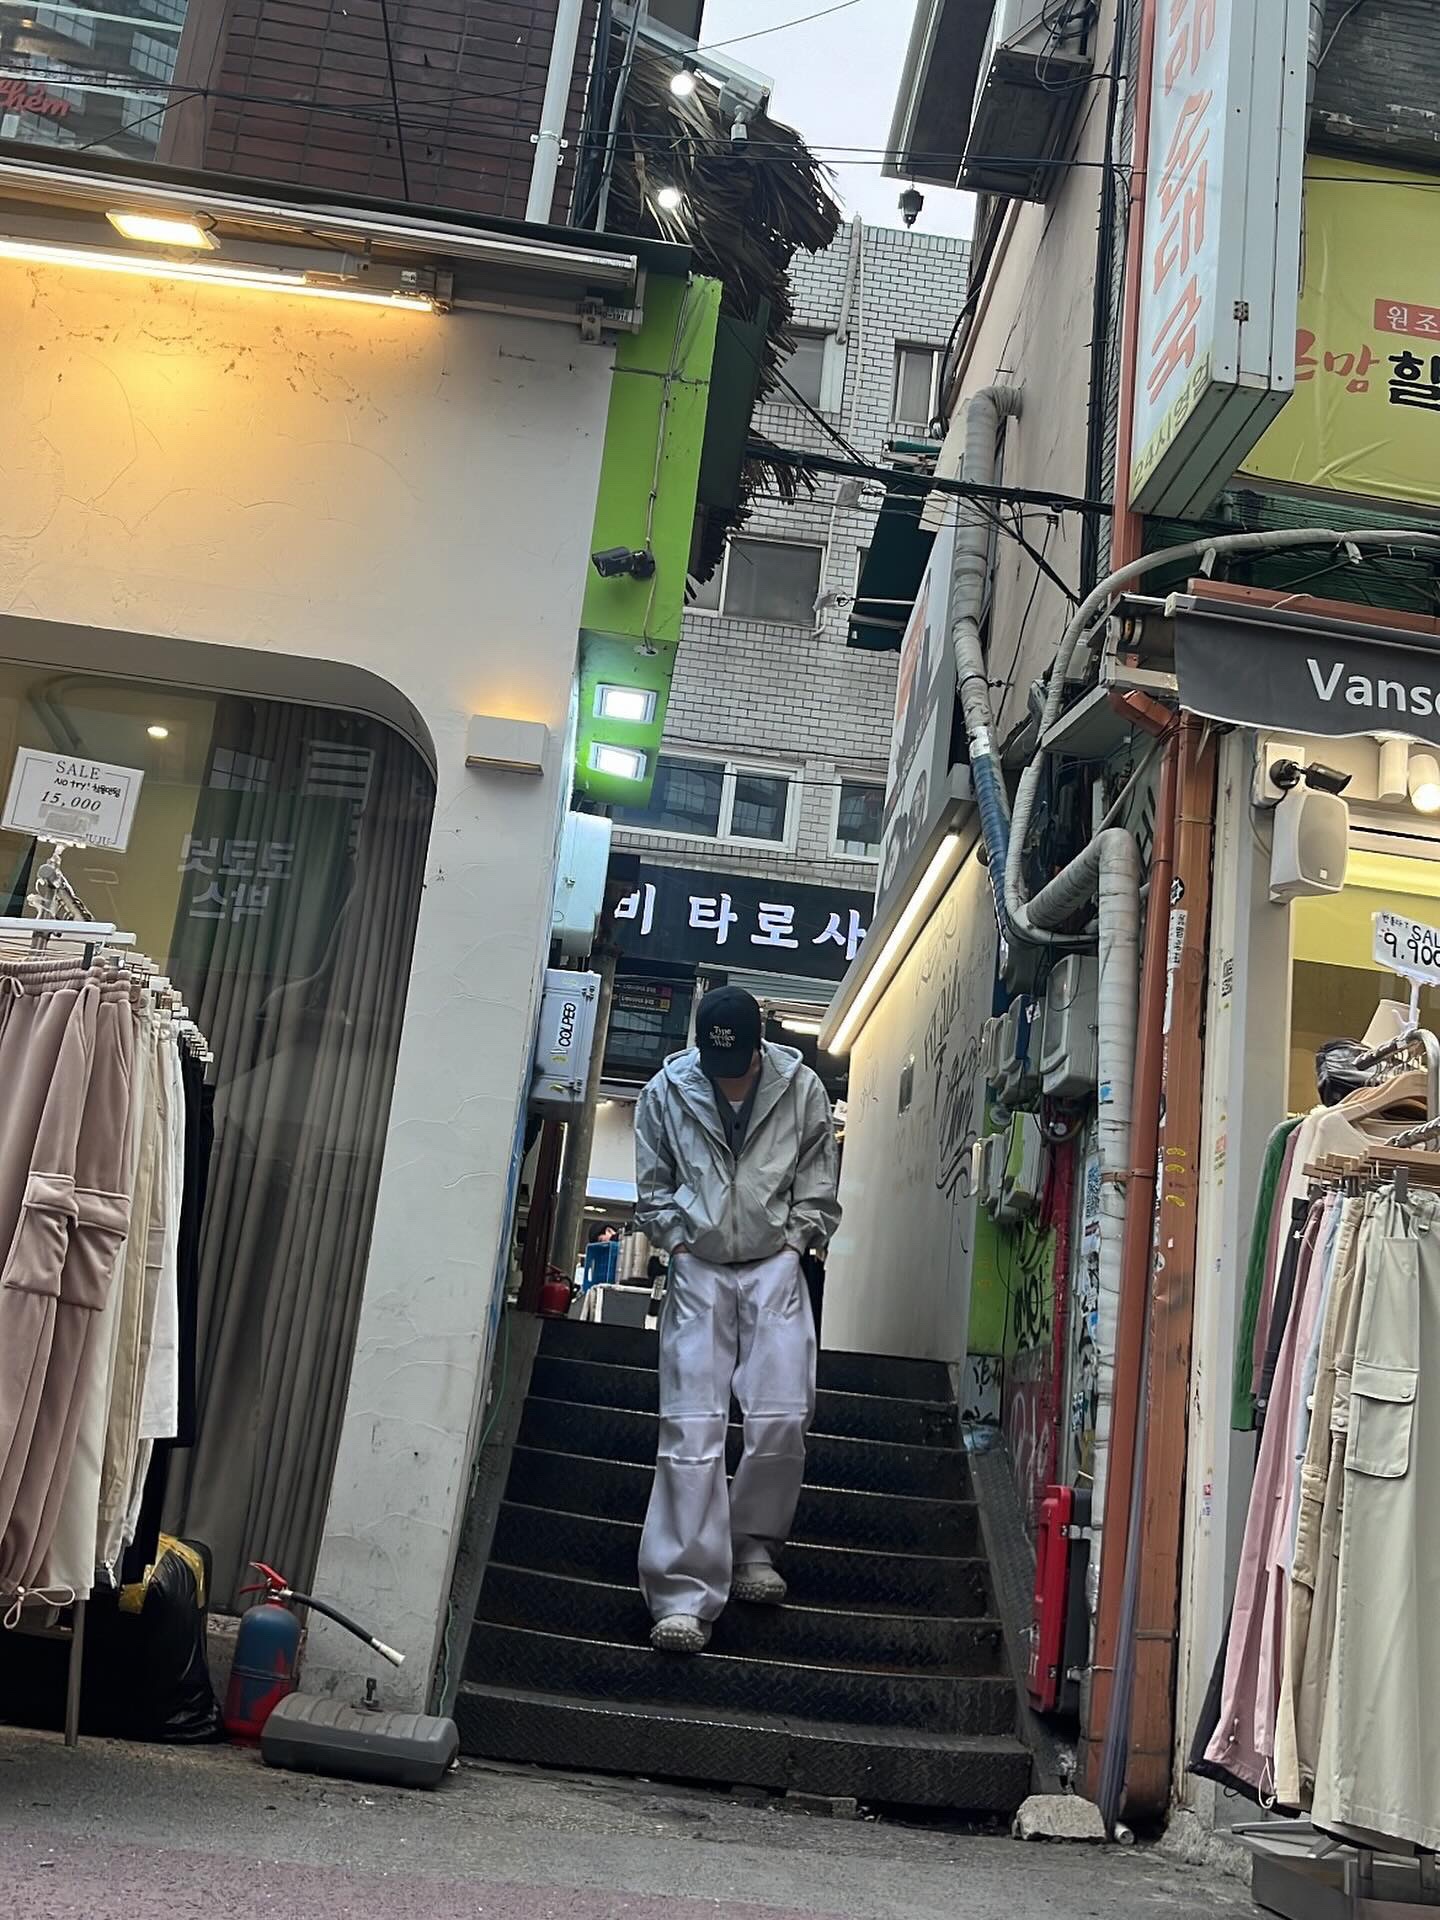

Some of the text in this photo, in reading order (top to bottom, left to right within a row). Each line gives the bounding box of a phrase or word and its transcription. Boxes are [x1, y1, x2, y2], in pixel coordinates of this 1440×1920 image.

[1386, 306, 1440, 334] 원조
[1132, 351, 1211, 490] 24시영업
[1306, 658, 1440, 716] Vans
[56, 759, 101, 780] SALE
[41, 790, 102, 812] 15,000
